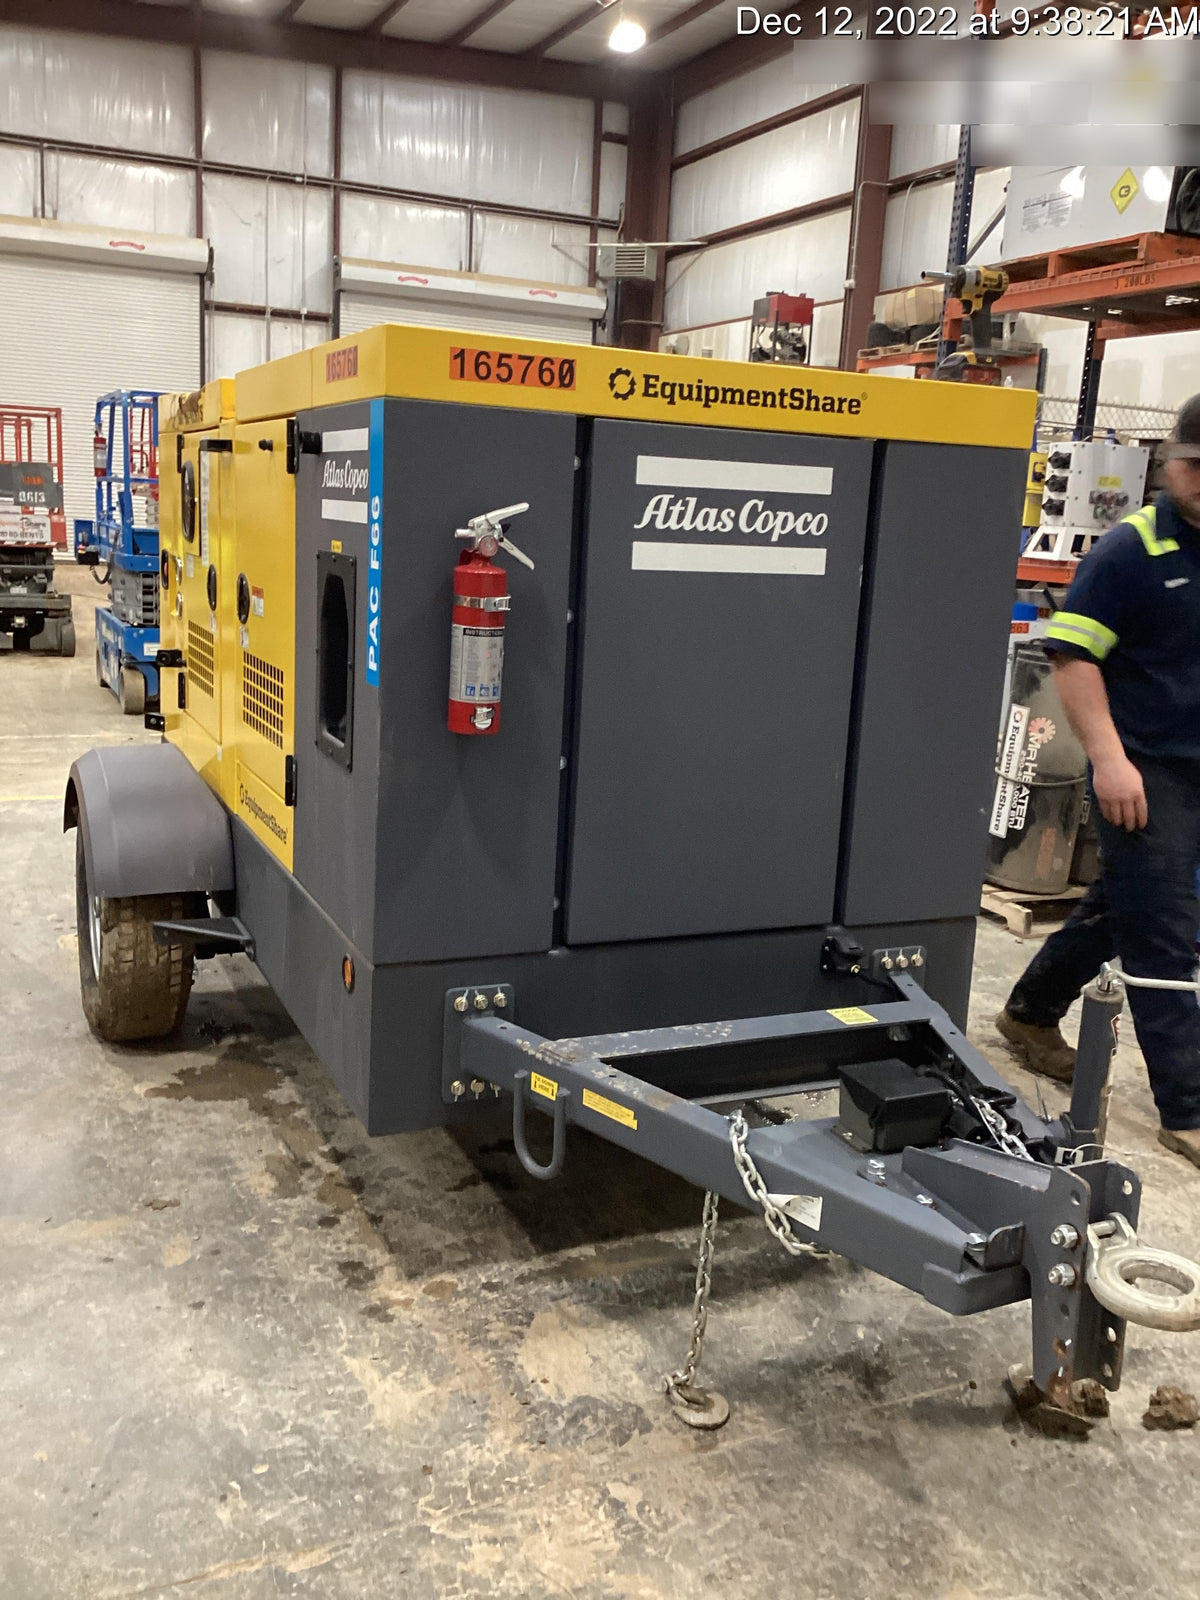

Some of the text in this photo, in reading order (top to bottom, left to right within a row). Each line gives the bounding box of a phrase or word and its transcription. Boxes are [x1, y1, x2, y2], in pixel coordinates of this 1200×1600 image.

[326, 345, 358, 382] 165760
[453, 349, 575, 388] 165760
[642, 373, 862, 415] EquipmentShare
[634, 494, 829, 542] Atlas Copco
[368, 495, 381, 672] PAC F66
[993, 725, 1021, 832] EquipmntShare
